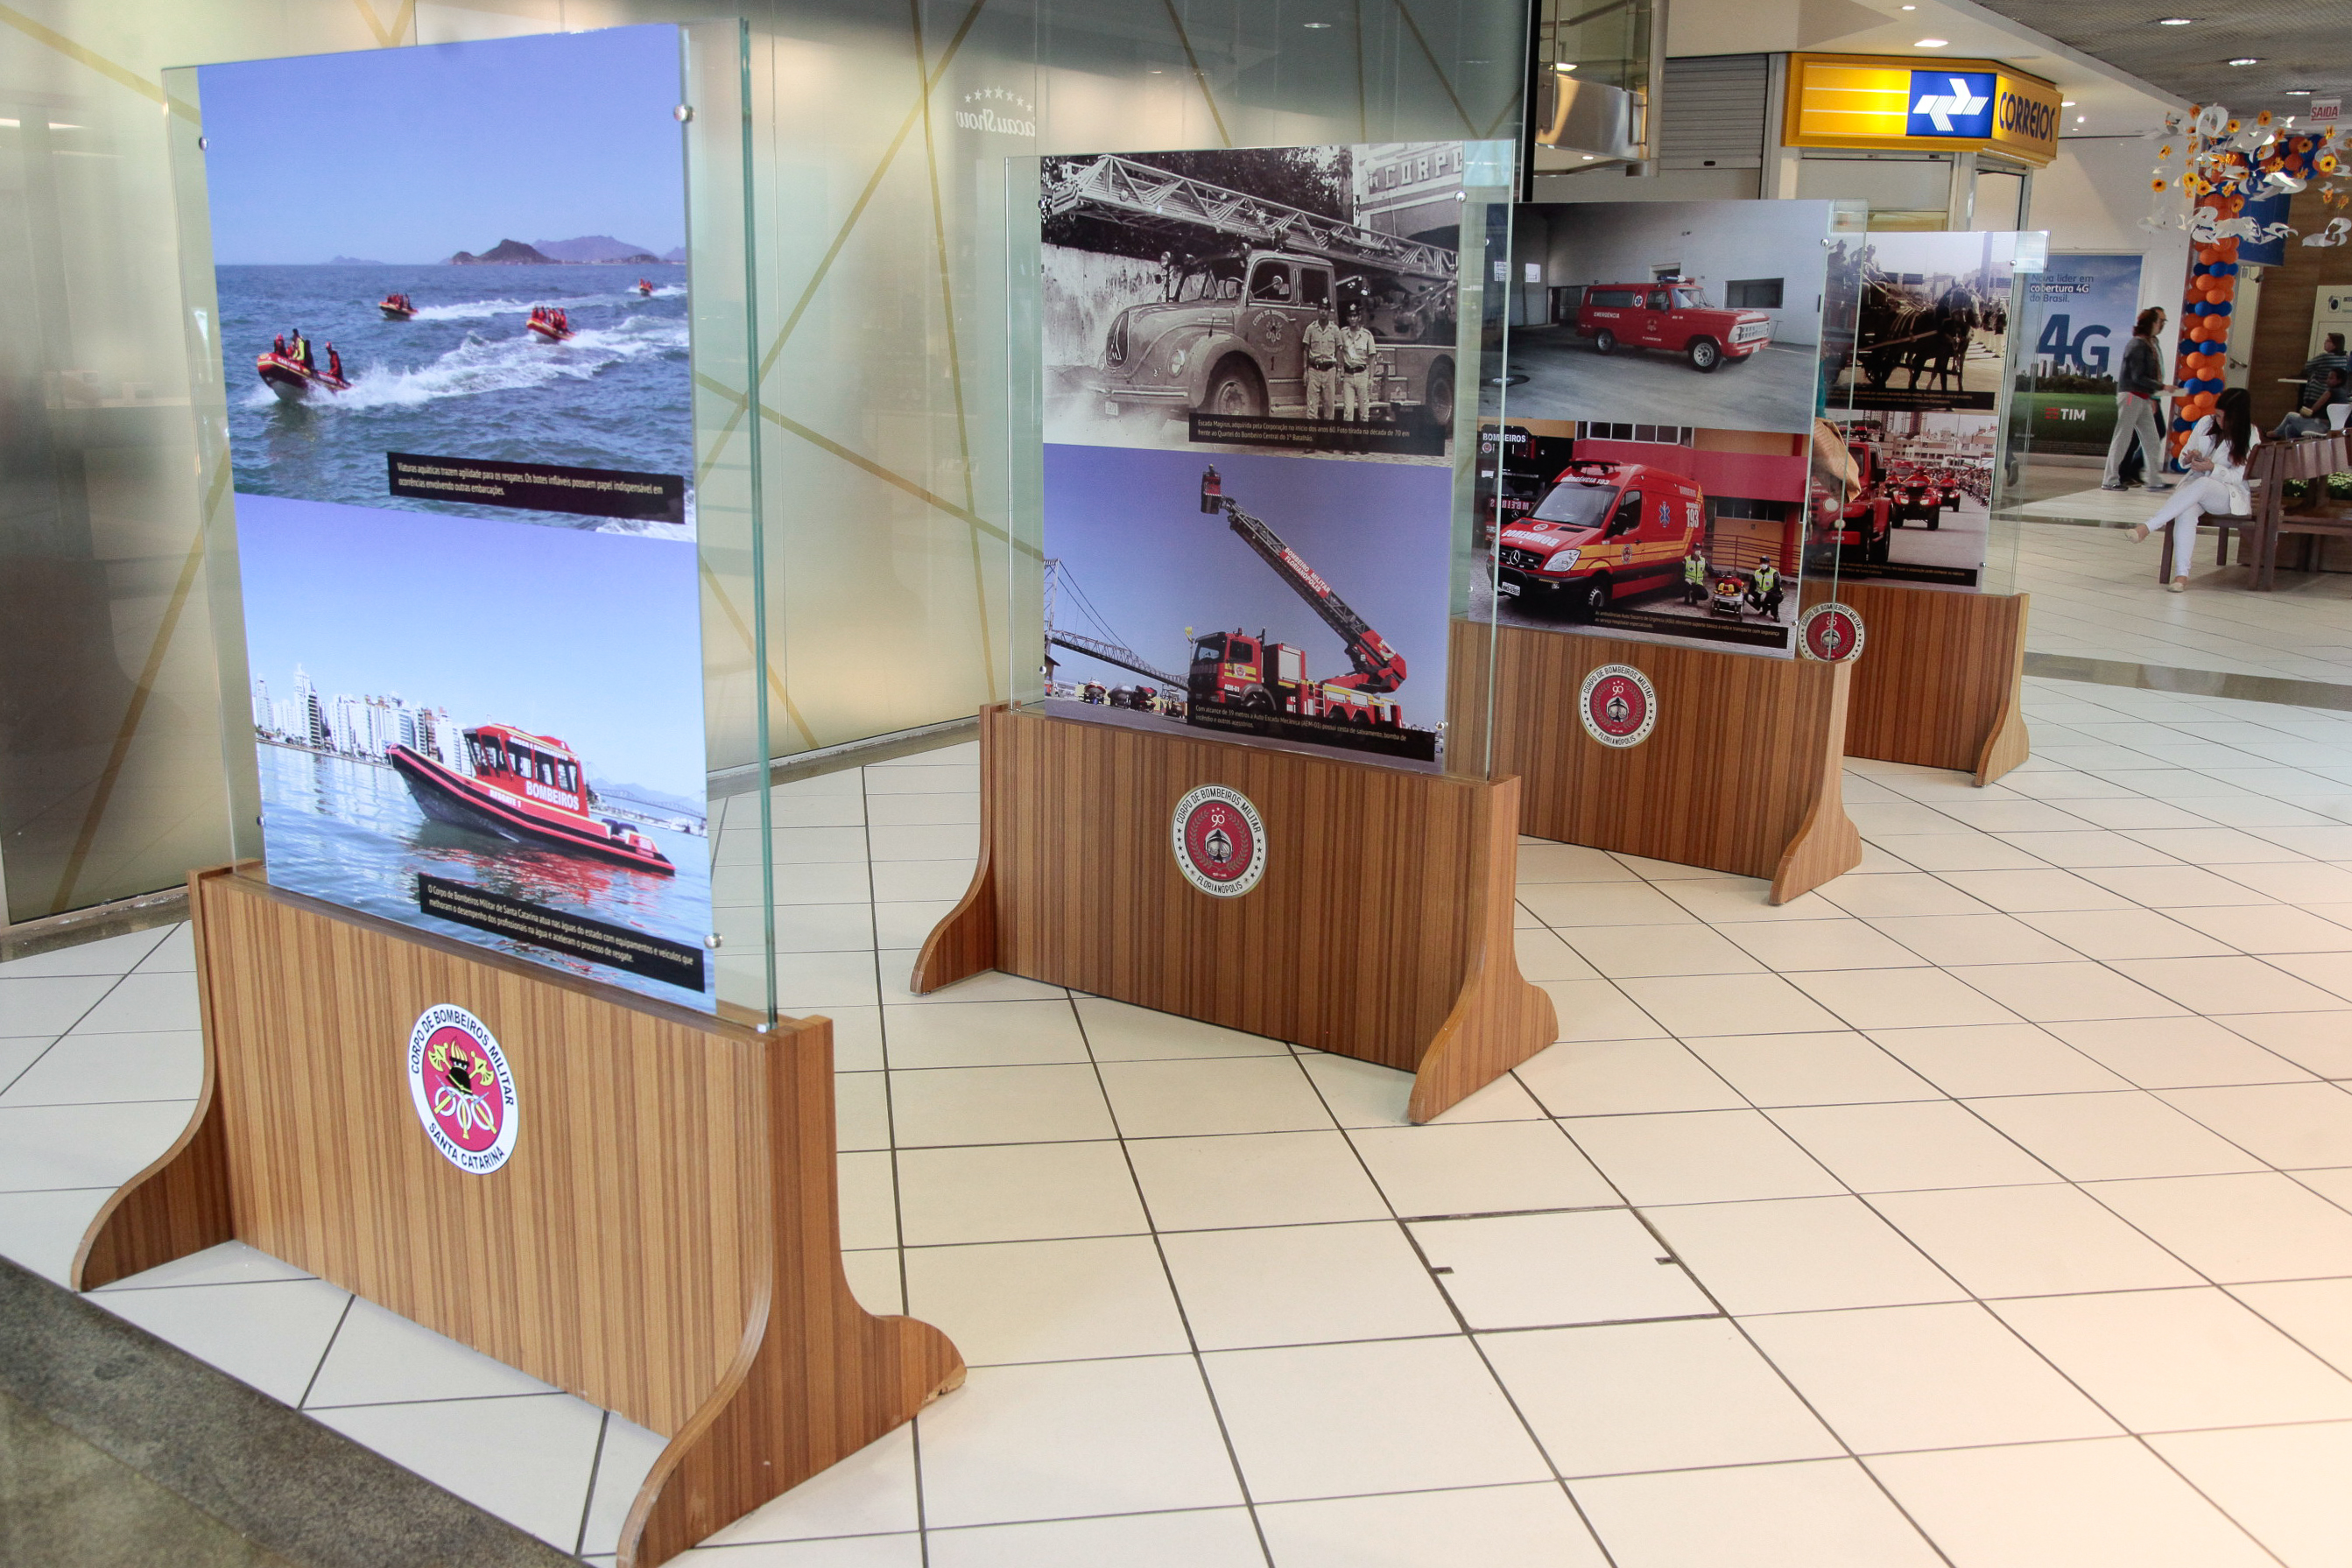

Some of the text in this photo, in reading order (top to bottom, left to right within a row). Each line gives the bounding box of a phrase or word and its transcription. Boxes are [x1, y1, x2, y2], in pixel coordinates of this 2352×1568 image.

[1999, 91, 2056, 143] CORREIOS
[2030, 283, 2089, 293] cobertura 4G
[2036, 313, 2112, 377] 4G
[2060, 408, 2087, 421] TIM
[1482, 432, 1526, 443] BOMEIROS
[1687, 508, 1700, 528] 193
[1285, 547, 1331, 594] BOMBEIRO MILITAR
[1820, 603, 1850, 614] BOMEIROS
[1583, 665, 1653, 699] CORPO DE BOMBEIROS MILITAR
[1612, 686, 1624, 696] 90
[525, 780, 580, 811] BOMBEIROS
[1176, 787, 1262, 833] CORPO DE BOMBEIROS MILITAR
[1211, 814, 1225, 828] 90
[1196, 875, 1243, 894] FLORIANÓPOLIS
[411, 1009, 515, 1106] CORPO DE BOMBEIROS MILITAR
[428, 1122, 505, 1171] SANTA CATARINA
